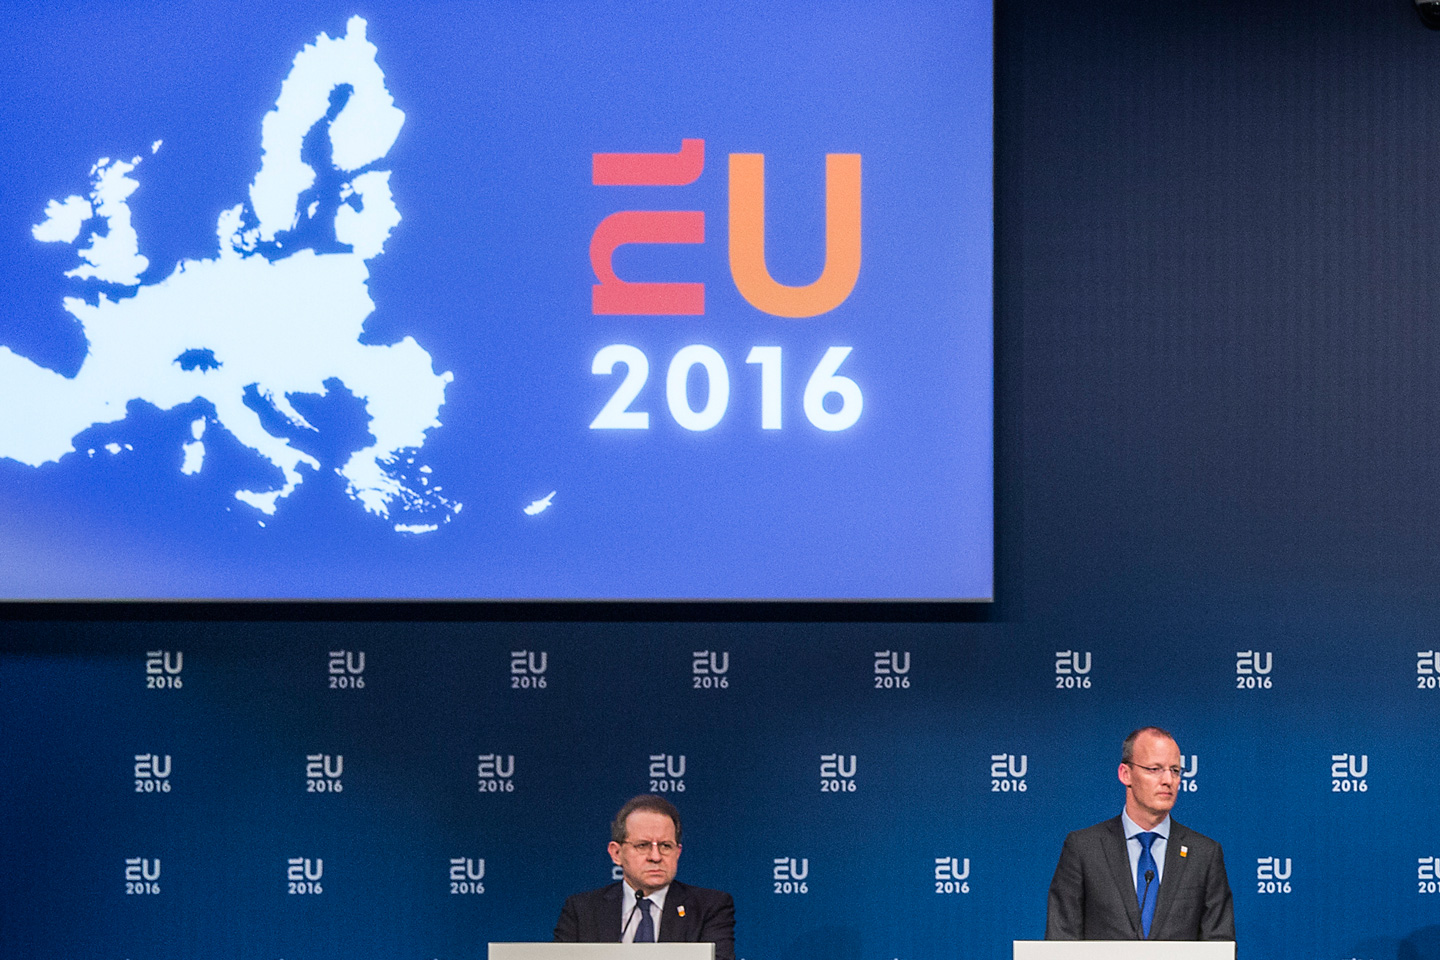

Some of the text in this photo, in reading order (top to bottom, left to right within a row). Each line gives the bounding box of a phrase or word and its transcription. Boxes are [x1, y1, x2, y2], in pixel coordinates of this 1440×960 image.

[589, 345, 864, 432] 2016
[146, 675, 183, 689] 2016
[328, 675, 366, 689] 2016
[510, 675, 548, 689] 2016
[692, 676, 729, 689] 2016
[874, 675, 911, 689] 2016
[1055, 675, 1092, 689] 2016
[1236, 676, 1273, 690] 2016
[134, 779, 172, 793] 2016
[306, 779, 344, 793] 2016
[477, 779, 515, 793] 2016
[649, 779, 686, 793] 2016
[820, 779, 857, 793] 2016
[990, 779, 1028, 793] 2016
[1331, 779, 1369, 793] 2016
[125, 881, 161, 895] 2016
[287, 881, 324, 895] 2016
[449, 881, 486, 895] 2016
[773, 881, 809, 894] 2016
[934, 881, 970, 894] 2016
[1257, 881, 1292, 894] 2016
